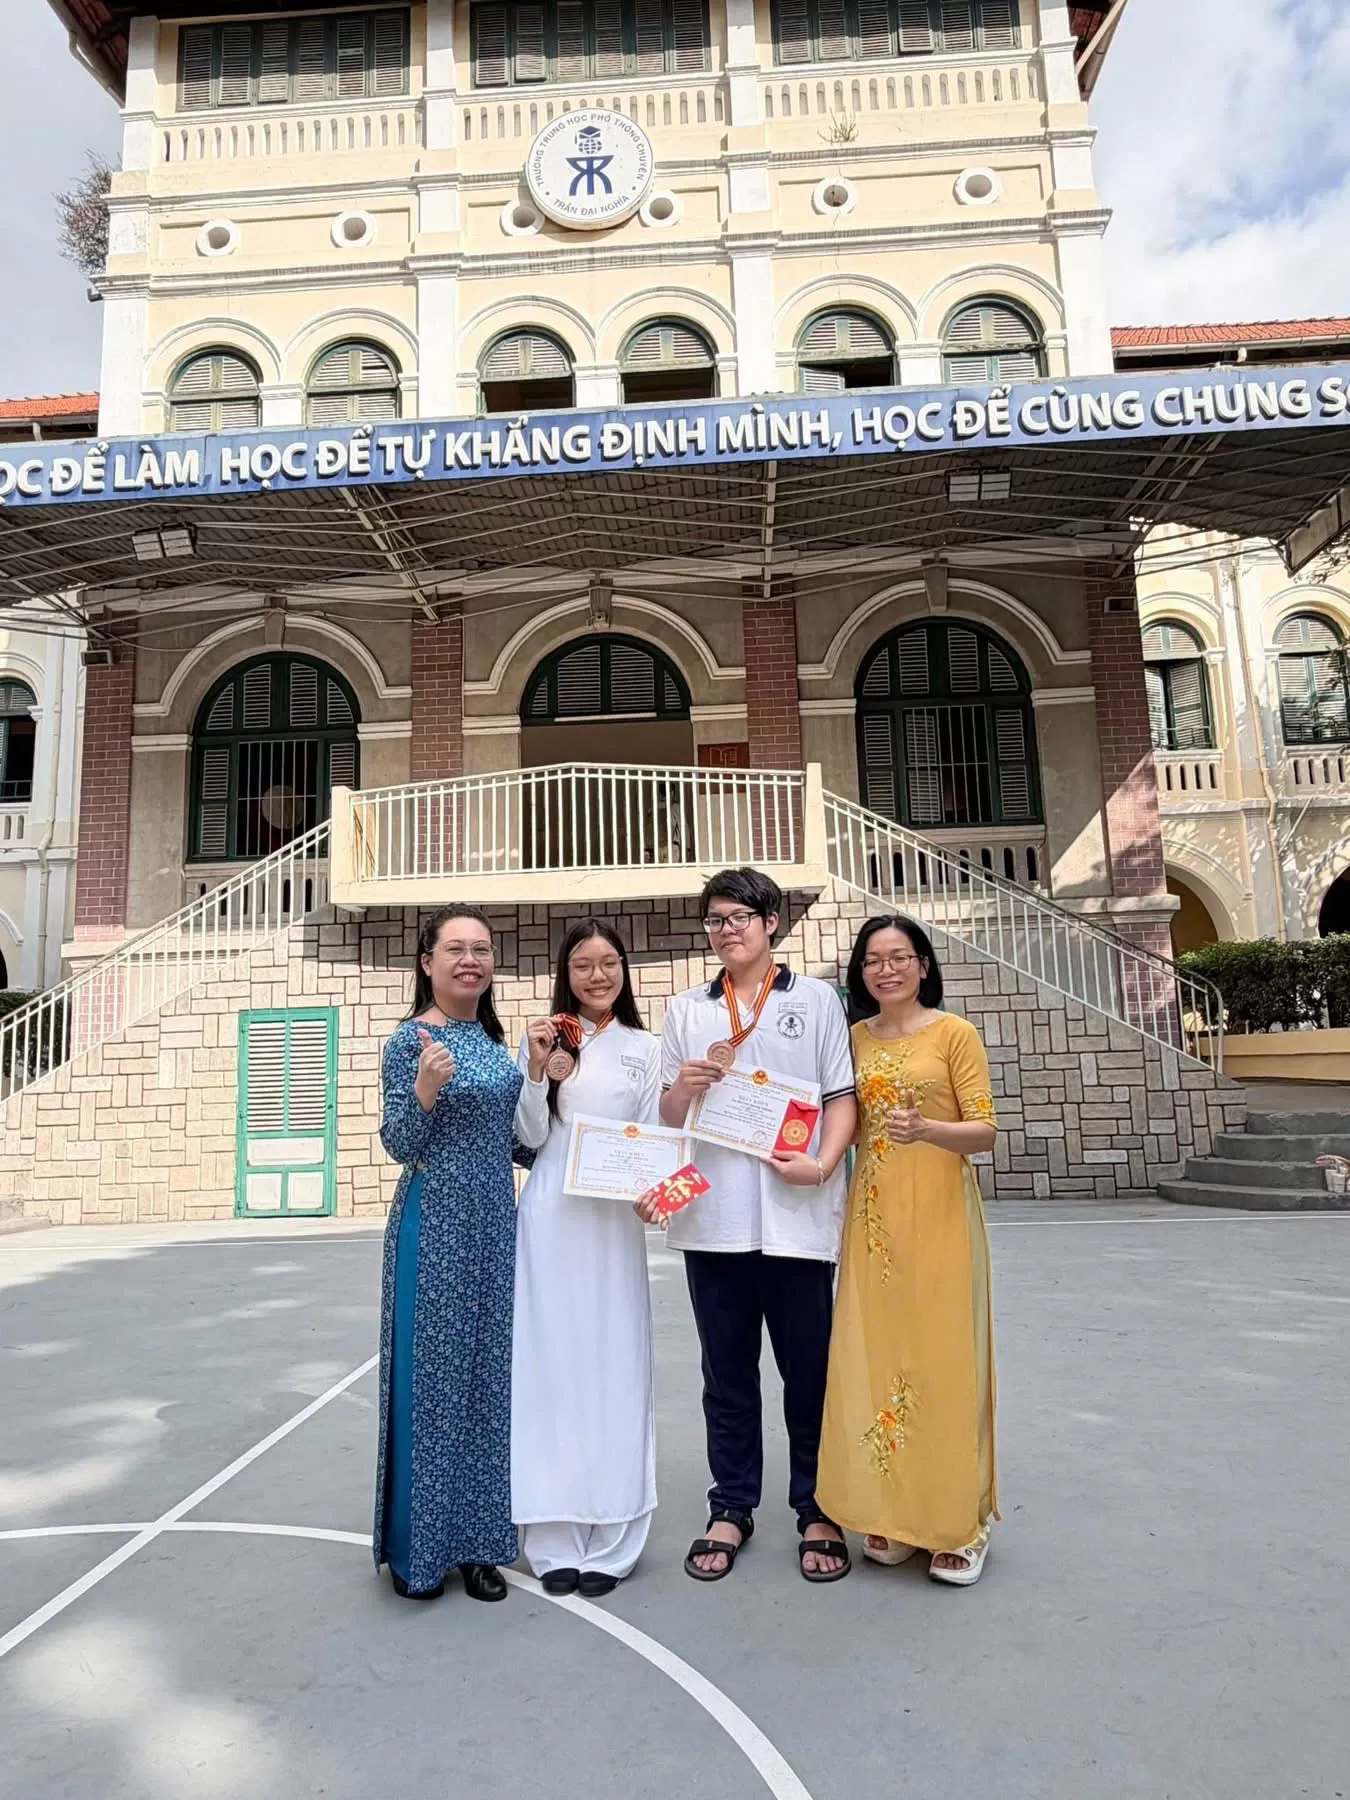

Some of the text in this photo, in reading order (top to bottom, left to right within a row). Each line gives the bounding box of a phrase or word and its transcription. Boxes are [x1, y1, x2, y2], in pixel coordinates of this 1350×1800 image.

[540, 122, 566, 148] TRUNG
[566, 114, 588, 126] HỌC
[614, 118, 640, 143] THÔNG
[636, 143, 648, 180] CHUYÊN
[50, 441, 109, 492] ĐỂ
[222, 443, 307, 490] HỌC
[316, 423, 375, 476] ĐỂ
[379, 429, 437, 480] TỰ
[444, 415, 592, 468] KHẲNG
[600, 416, 707, 466] ĐỊNH
[719, 403, 842, 452] MÌNH,
[854, 402, 943, 448] HỌC
[953, 384, 1012, 437] ĐỂ
[1021, 386, 1146, 432] CÙNG
[1154, 380, 1310, 427] CHUNG
[1320, 376, 1350, 414] S
